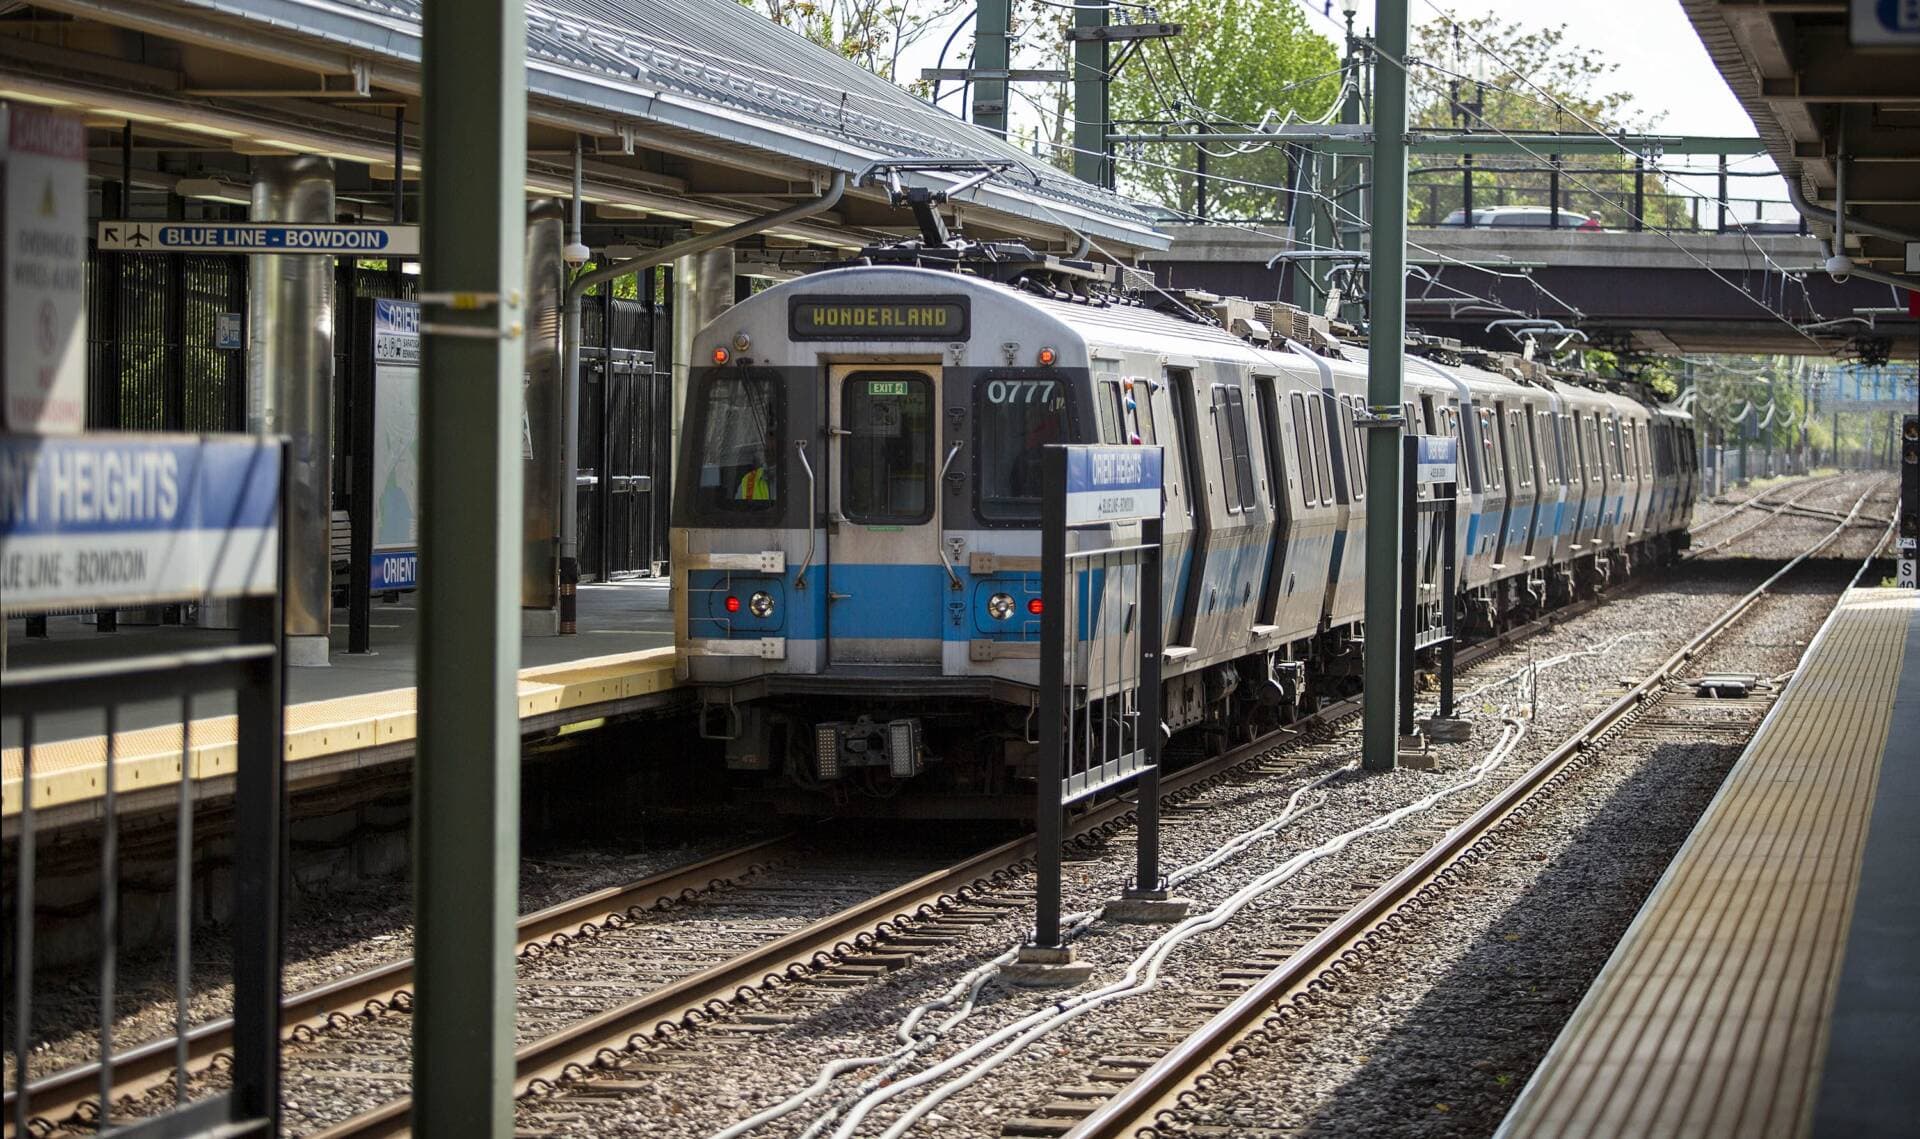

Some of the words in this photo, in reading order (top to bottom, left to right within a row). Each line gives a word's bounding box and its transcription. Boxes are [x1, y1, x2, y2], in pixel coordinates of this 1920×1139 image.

[166, 229, 218, 246] BLUE
[223, 230, 267, 247] LINE
[285, 231, 380, 248] BOWDOIN
[813, 308, 946, 326] WONDERLAND
[873, 383, 893, 393] EXIT
[988, 381, 1055, 404] 0777
[51, 450, 179, 523] HEIGHTS
[27, 552, 62, 589] LINE
[76, 549, 147, 586] BOWDOIN
[384, 557, 417, 583] ORIENT
[1902, 562, 1912, 577] S
